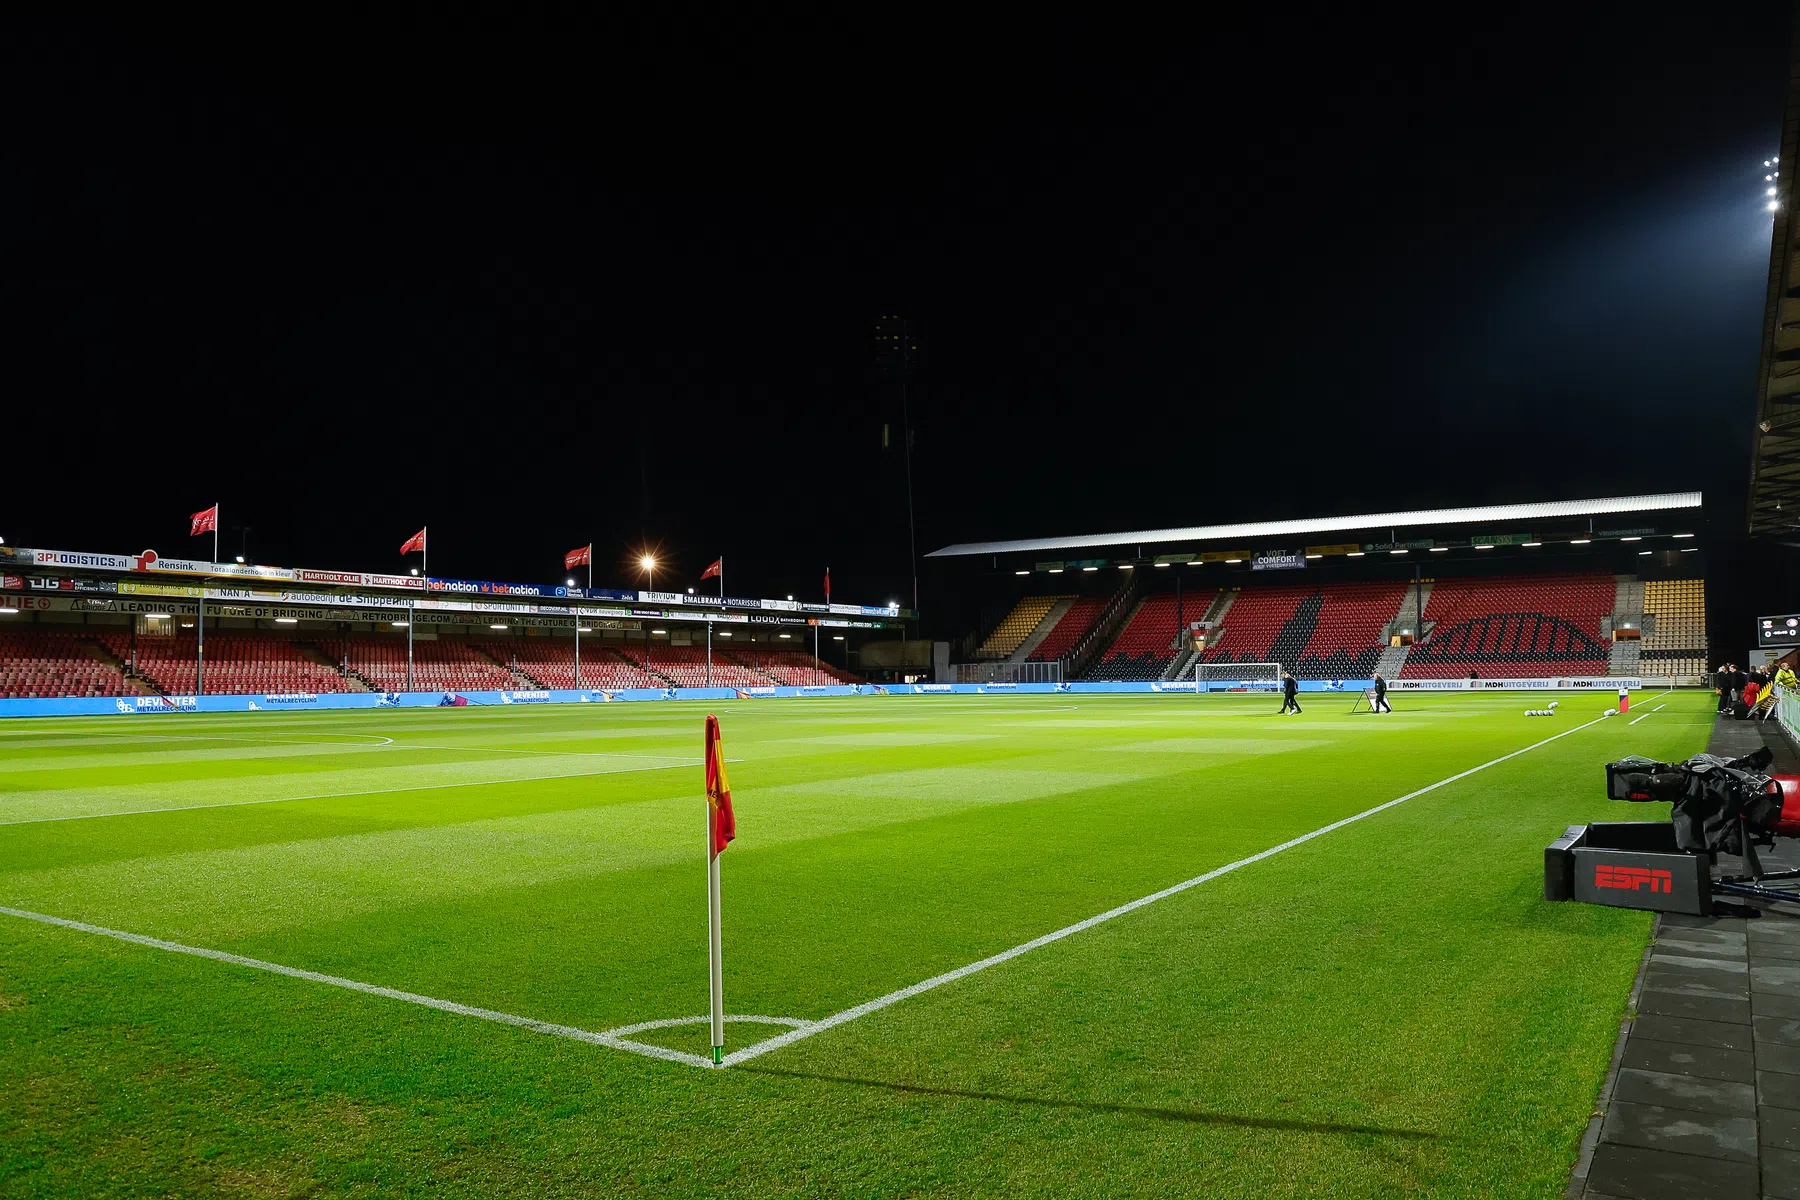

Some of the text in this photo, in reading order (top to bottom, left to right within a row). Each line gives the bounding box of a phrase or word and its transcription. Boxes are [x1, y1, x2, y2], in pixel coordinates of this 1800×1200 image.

[1374, 542, 1393, 550] Solid
[1266, 549, 1287, 557] VOET
[37, 552, 127, 568] 3PLOGISTICS.nl
[1257, 555, 1297, 565] COMFORT
[304, 572, 342, 581] HARTHOLT
[373, 577, 407, 586] HARTHOLT
[427, 581, 540, 596] betnation betnation
[646, 592, 676, 600] TRIVIUM
[683, 595, 722, 605] SMALBRAAK
[727, 598, 760, 607] NOTARISSEN
[120, 602, 176, 613] LEADING
[180, 604, 199, 614] TH
[206, 606, 252, 616] FUTURE
[254, 607, 269, 617] OF
[272, 608, 323, 619] BRIDGING
[483, 617, 519, 626] LEADING
[521, 618, 536, 626] THE
[538, 618, 568, 627] FUTURE
[1595, 864, 1672, 894] ESPN
